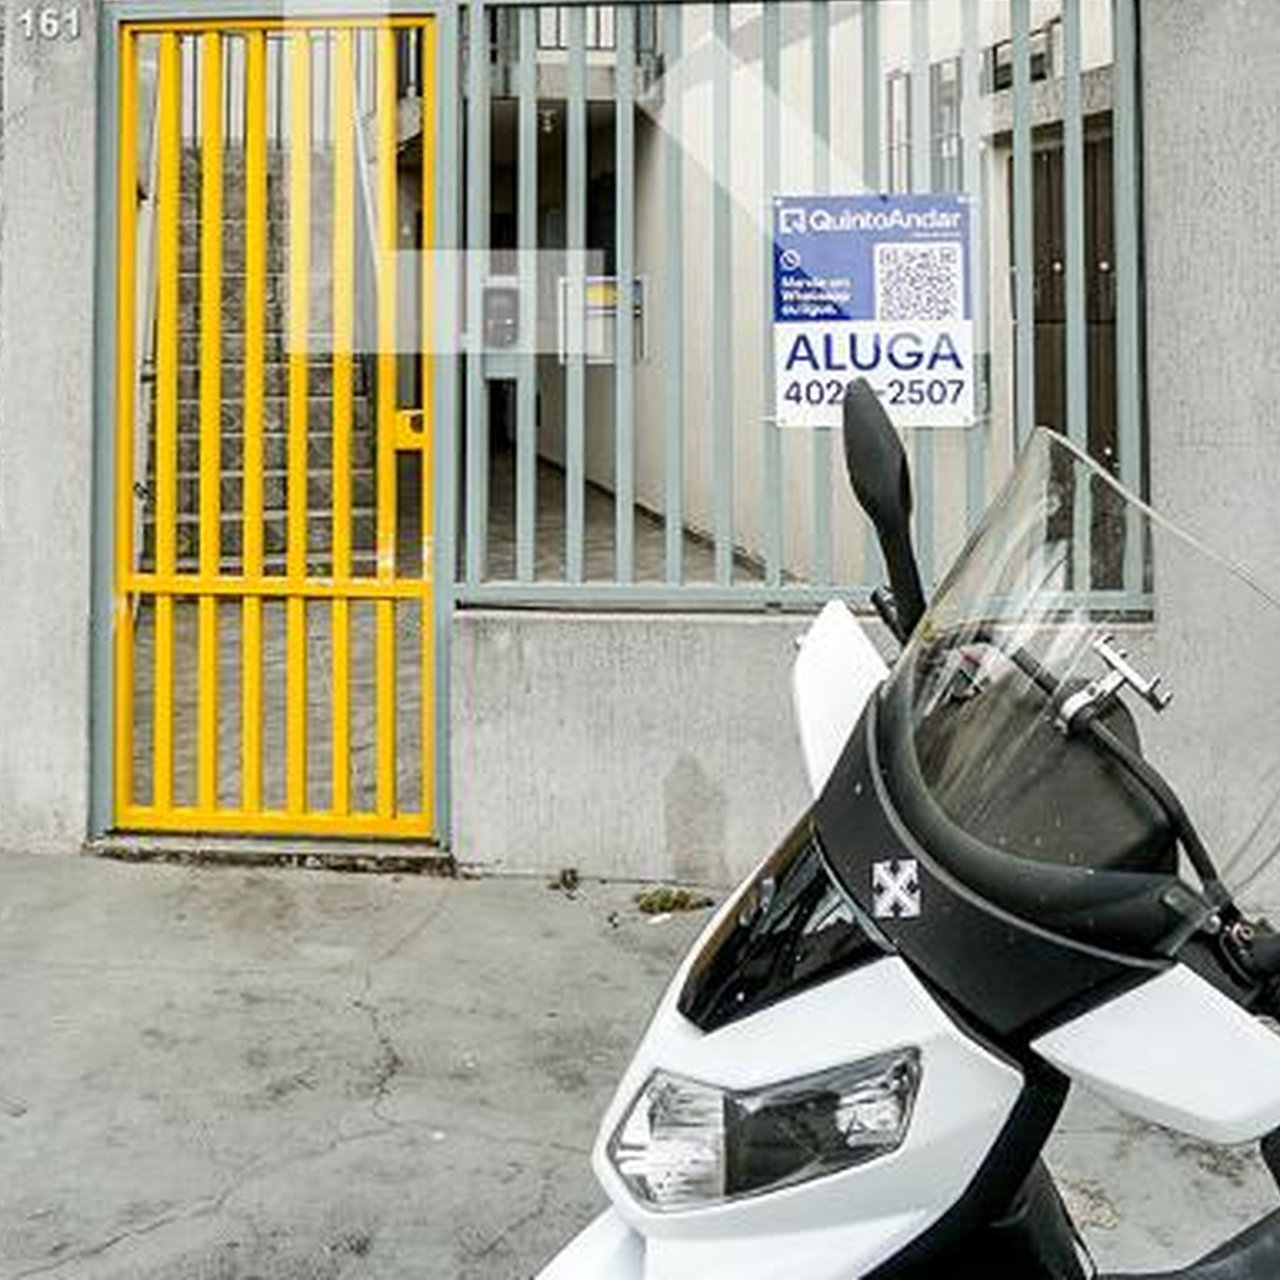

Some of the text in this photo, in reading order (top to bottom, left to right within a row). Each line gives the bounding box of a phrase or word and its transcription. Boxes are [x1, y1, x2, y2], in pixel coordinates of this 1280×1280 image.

[19, 7, 78, 37] 161
[809, 208, 961, 231] QuintoAndar
[785, 332, 964, 371] ALUGA
[785, 378, 965, 405] 402-2507
